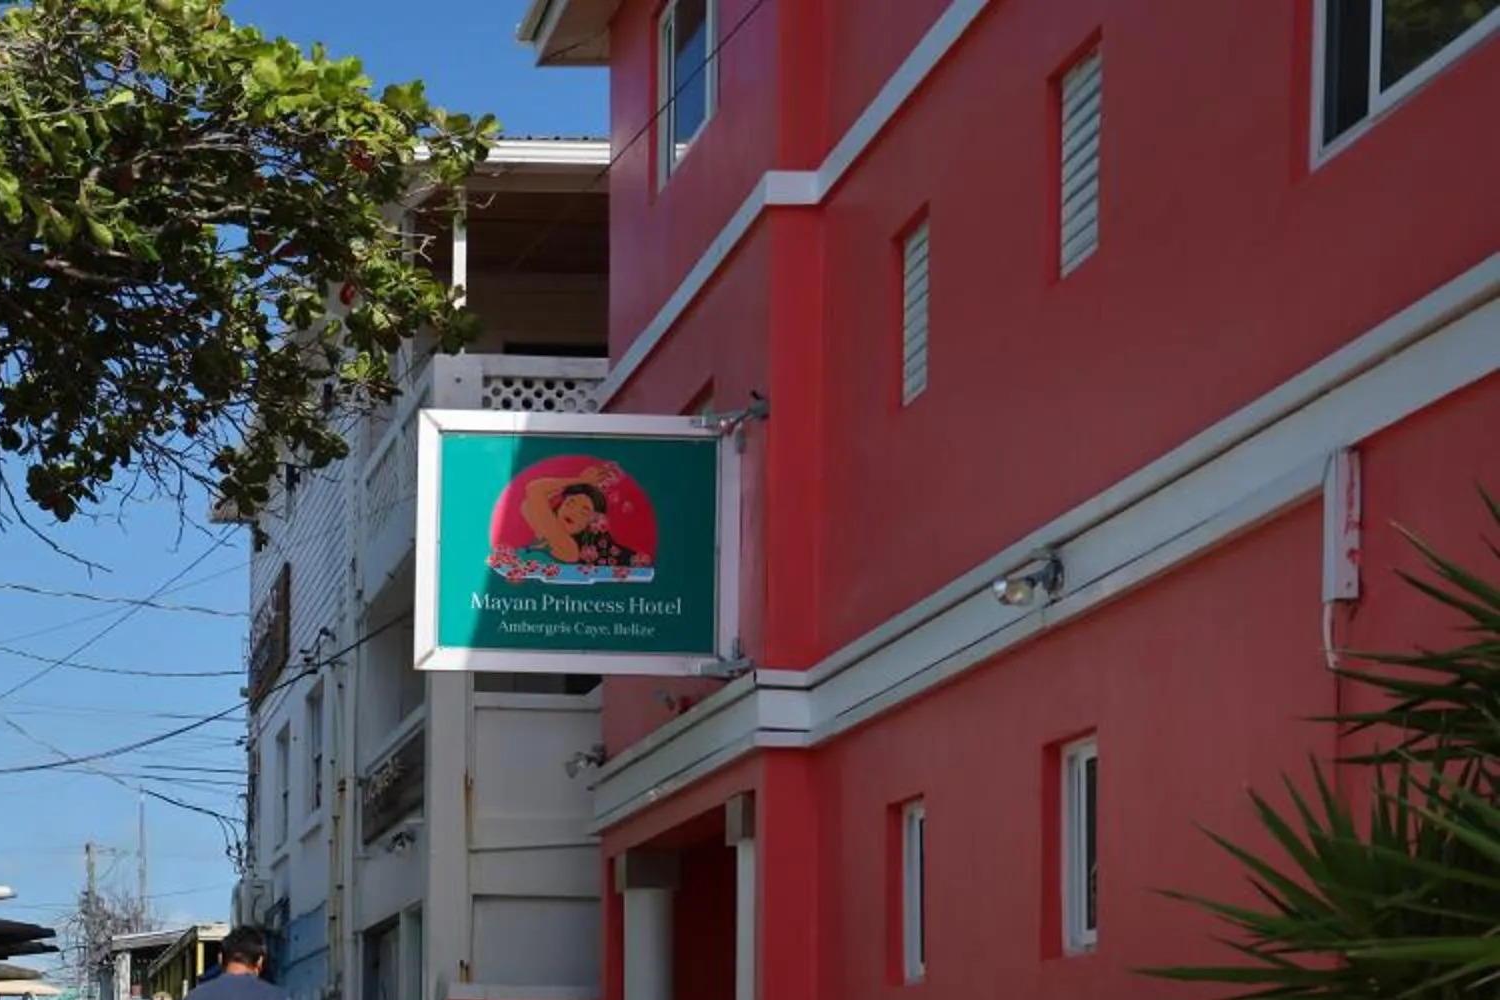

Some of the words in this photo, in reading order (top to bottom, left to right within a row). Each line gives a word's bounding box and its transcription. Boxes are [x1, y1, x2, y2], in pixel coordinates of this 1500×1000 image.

[471, 592, 537, 615] Mayan
[541, 594, 624, 614] Princess
[629, 597, 682, 615] Hotel
[499, 621, 571, 637] Ambergris
[613, 623, 656, 637] Belize
